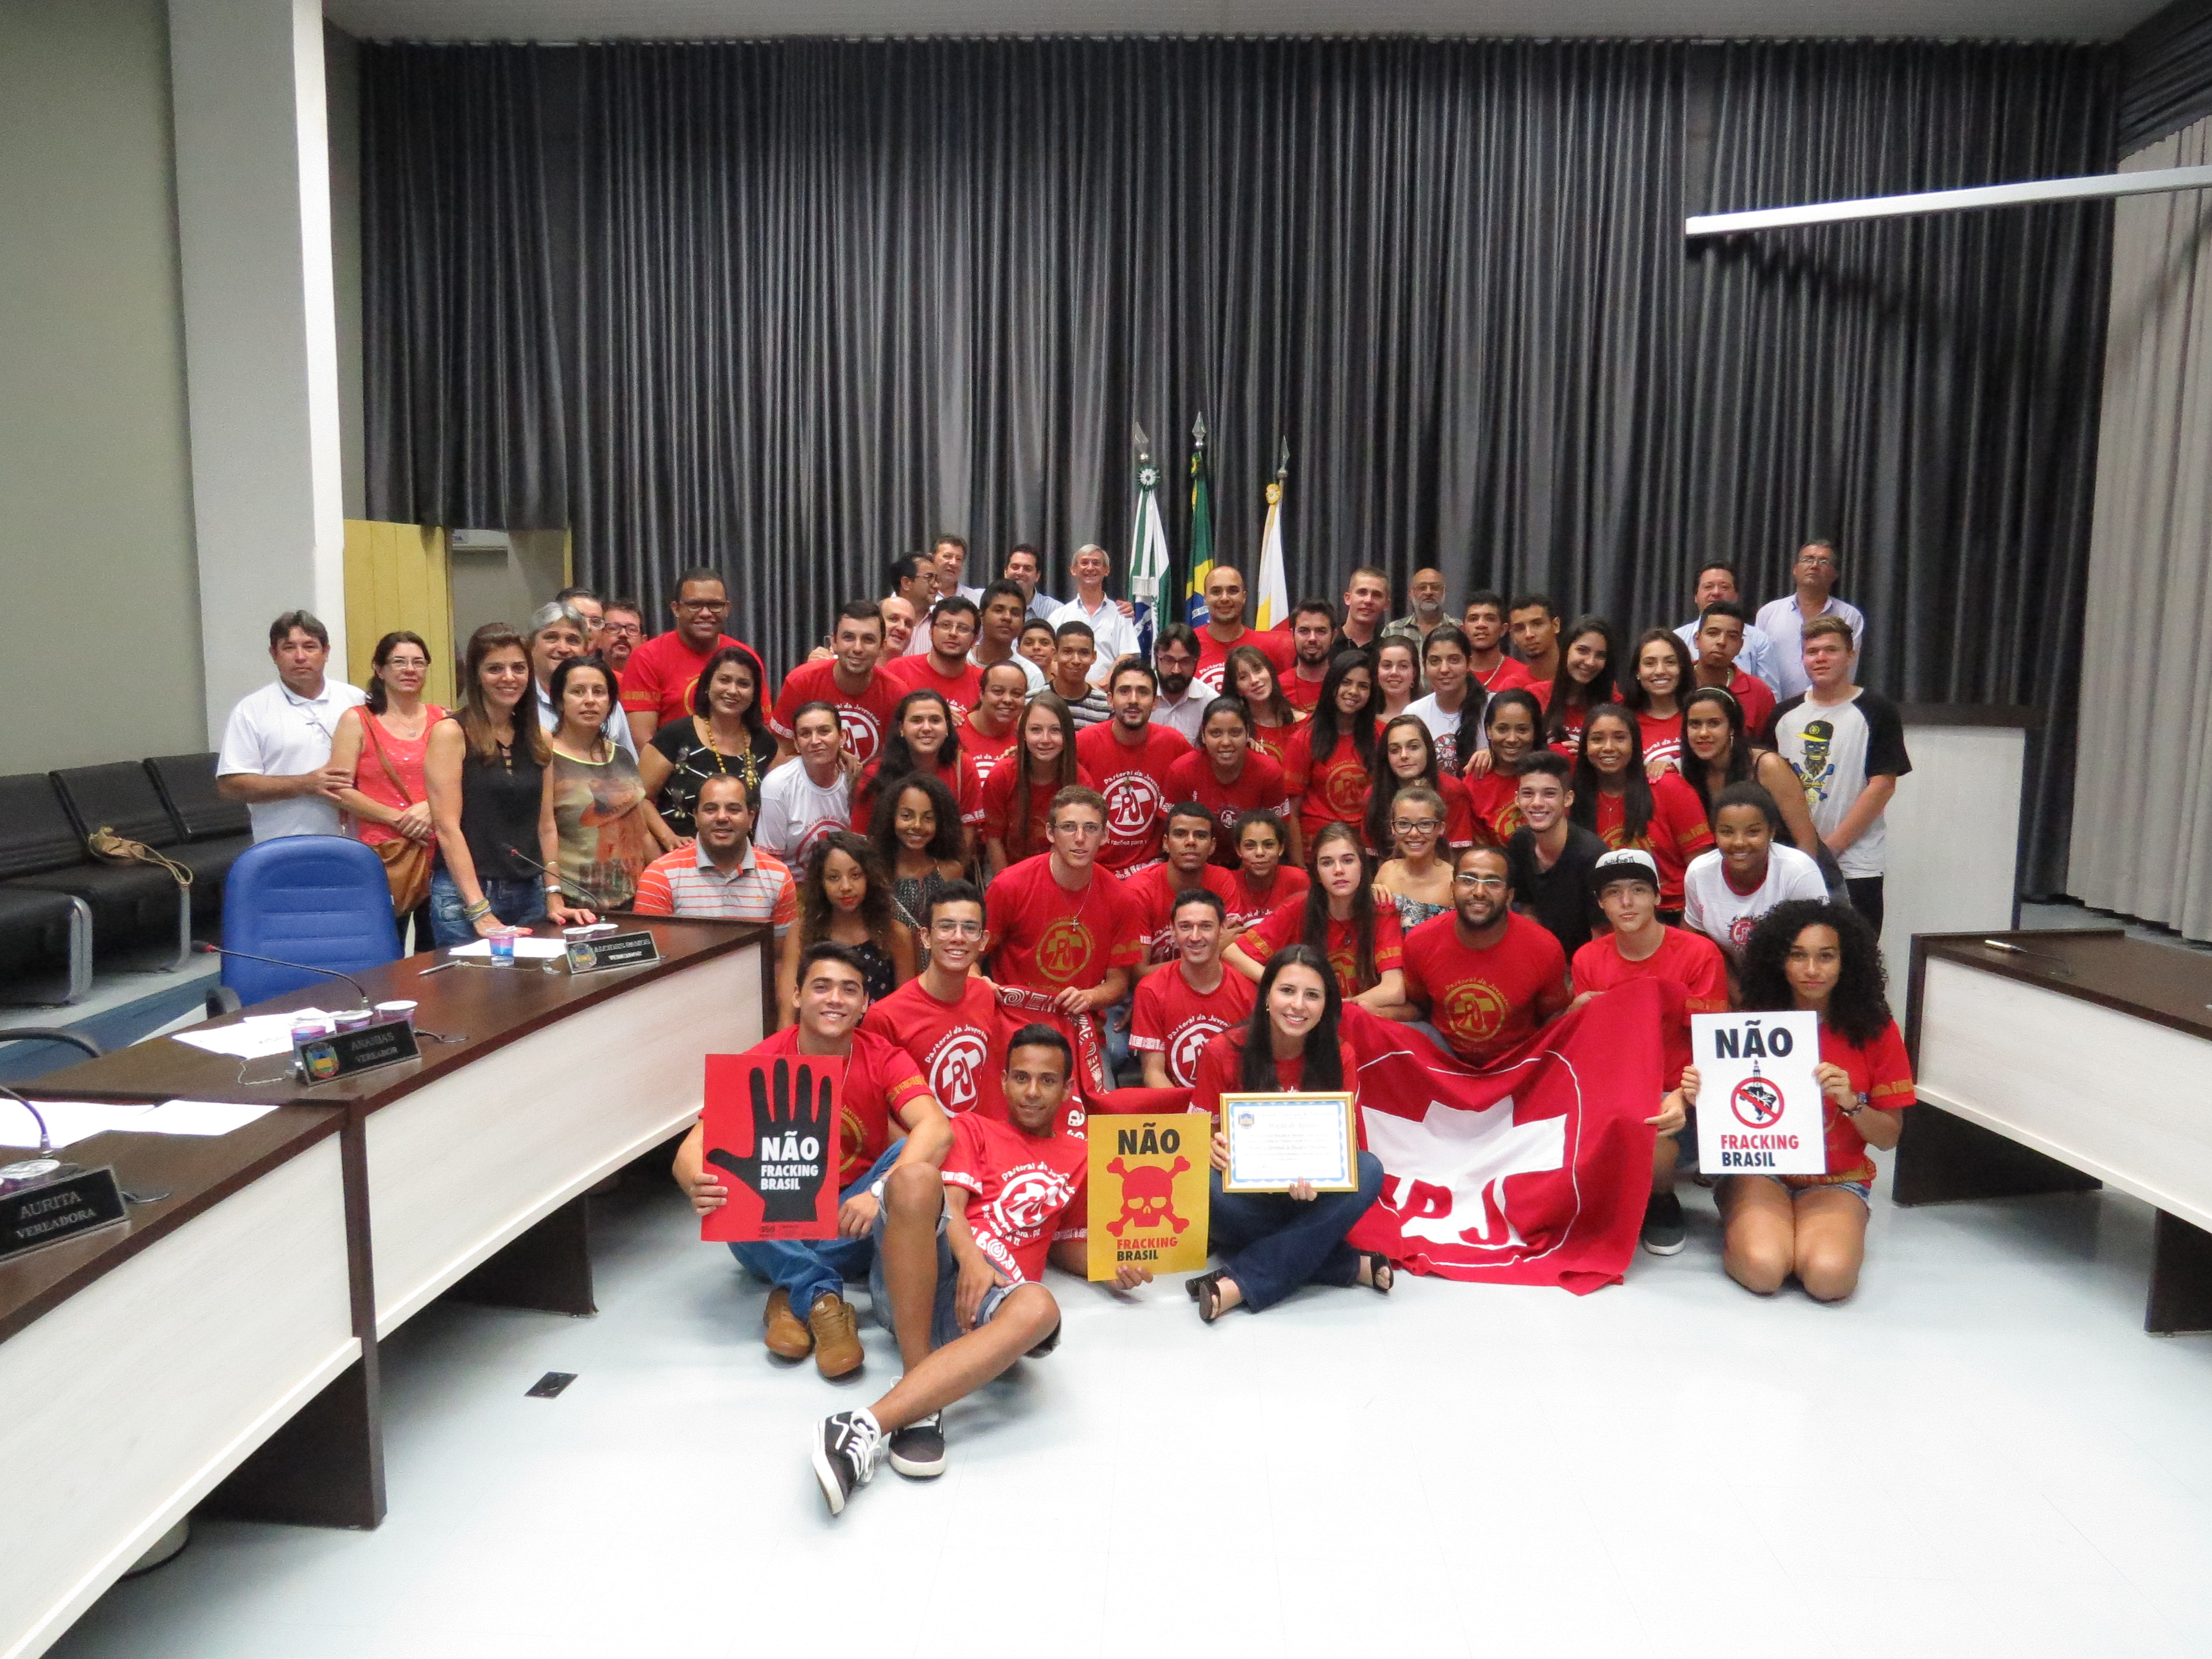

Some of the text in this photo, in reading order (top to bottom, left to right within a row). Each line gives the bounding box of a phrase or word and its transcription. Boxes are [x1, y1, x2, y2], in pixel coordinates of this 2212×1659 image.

[1199, 662, 1224, 674] Pastoral
[1103, 770, 1133, 785] Pastoral
[1444, 977, 1476, 991] Pastoral
[1167, 1016, 1195, 1040] Pastoral
[924, 1030, 952, 1063] Pastoral
[953, 1025, 963, 1035] da
[1715, 1019, 1793, 1058] NÃO
[761, 1130, 820, 1161] NÃO
[1118, 1122, 1180, 1155] NÃO
[1720, 1134, 1799, 1150] FRACKING
[1721, 1151, 1776, 1167] BRASIL
[761, 1165, 819, 1177] FRACKING
[1001, 1162, 1035, 1182] Pastoral
[1037, 1161, 1048, 1171] da
[760, 1178, 801, 1191] BRASIL
[20, 1191, 82, 1220] AURITA
[1117, 1237, 1178, 1250] FRACKING
[1117, 1249, 1159, 1261] BRASIL
